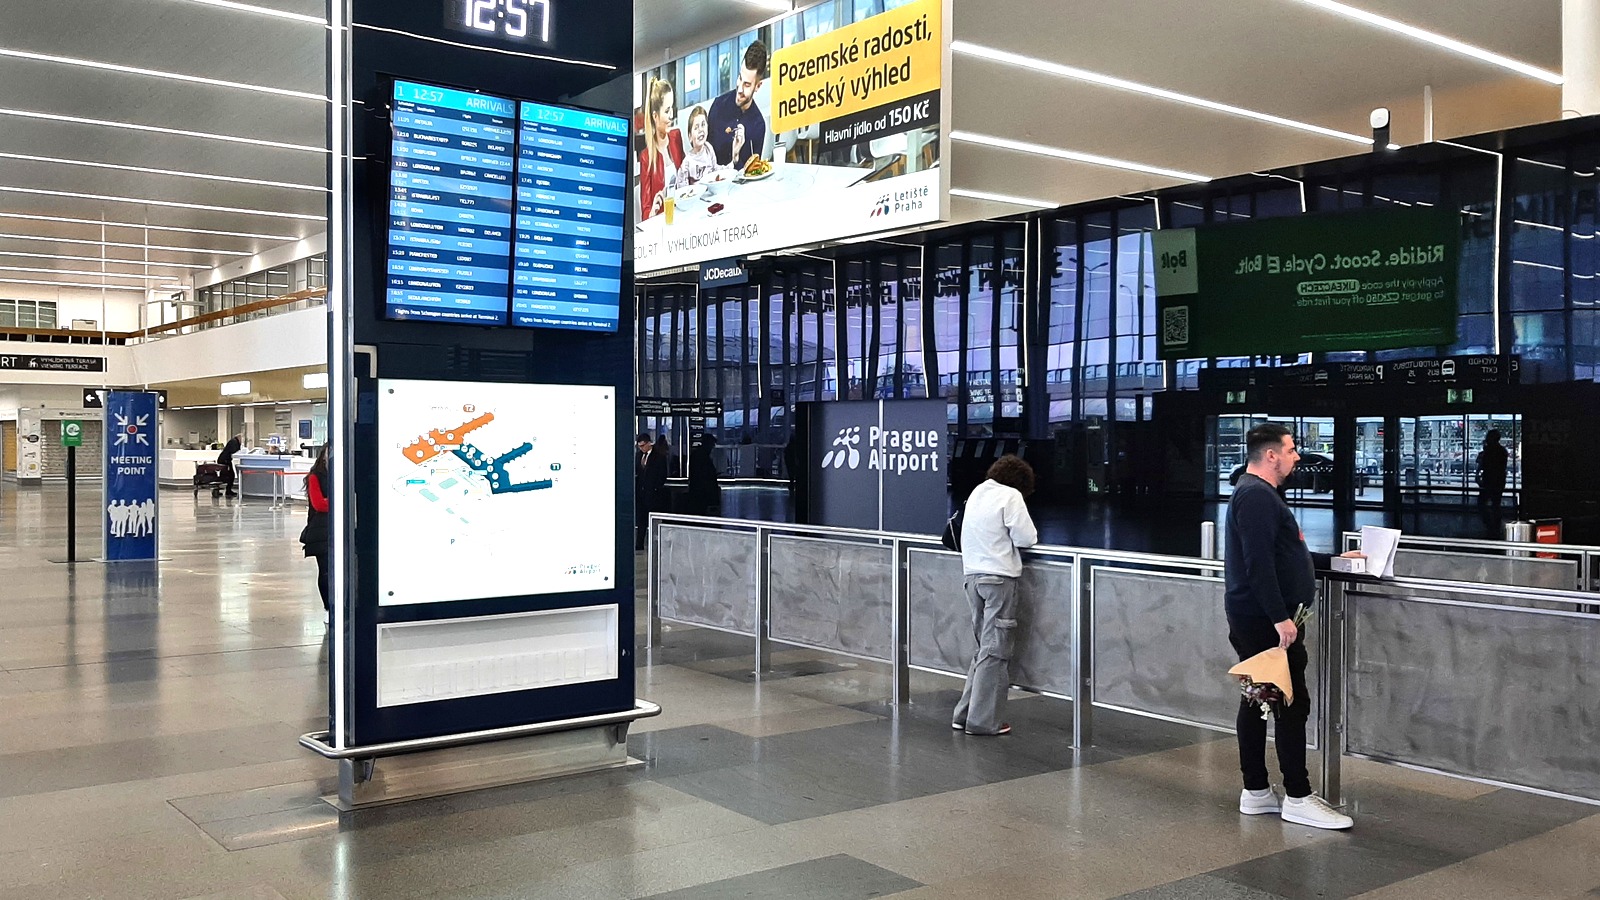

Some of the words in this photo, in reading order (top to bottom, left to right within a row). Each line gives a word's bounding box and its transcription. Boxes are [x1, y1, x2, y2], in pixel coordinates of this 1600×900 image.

[465, 0, 550, 42] 12:57
[779, 37, 858, 86] Pozemské
[863, 14, 932, 59] radosti,
[397, 86, 404, 97] 1
[413, 88, 444, 102] 12:57
[466, 97, 514, 114] ARRIVALS
[778, 76, 845, 118] nebeský
[850, 56, 911, 100] výhled
[523, 107, 530, 117] 2
[538, 109, 565, 121] 12:57
[584, 117, 627, 133] ARRIVALS
[825, 124, 852, 144] Hlavní
[854, 121, 872, 139] jídlo
[874, 115, 886, 131] od
[888, 106, 911, 127] 150
[913, 99, 930, 121] Kč
[894, 186, 929, 202] Letiště
[894, 200, 923, 213] Praha
[667, 227, 720, 253] VYHLÍDKOVÁ
[723, 223, 759, 242] TERASA
[703, 267, 743, 281] JCDecaux
[869, 426, 939, 453] Prague
[111, 456, 152, 465] MEETING
[117, 467, 146, 475] POINT
[868, 449, 939, 476] Airport
